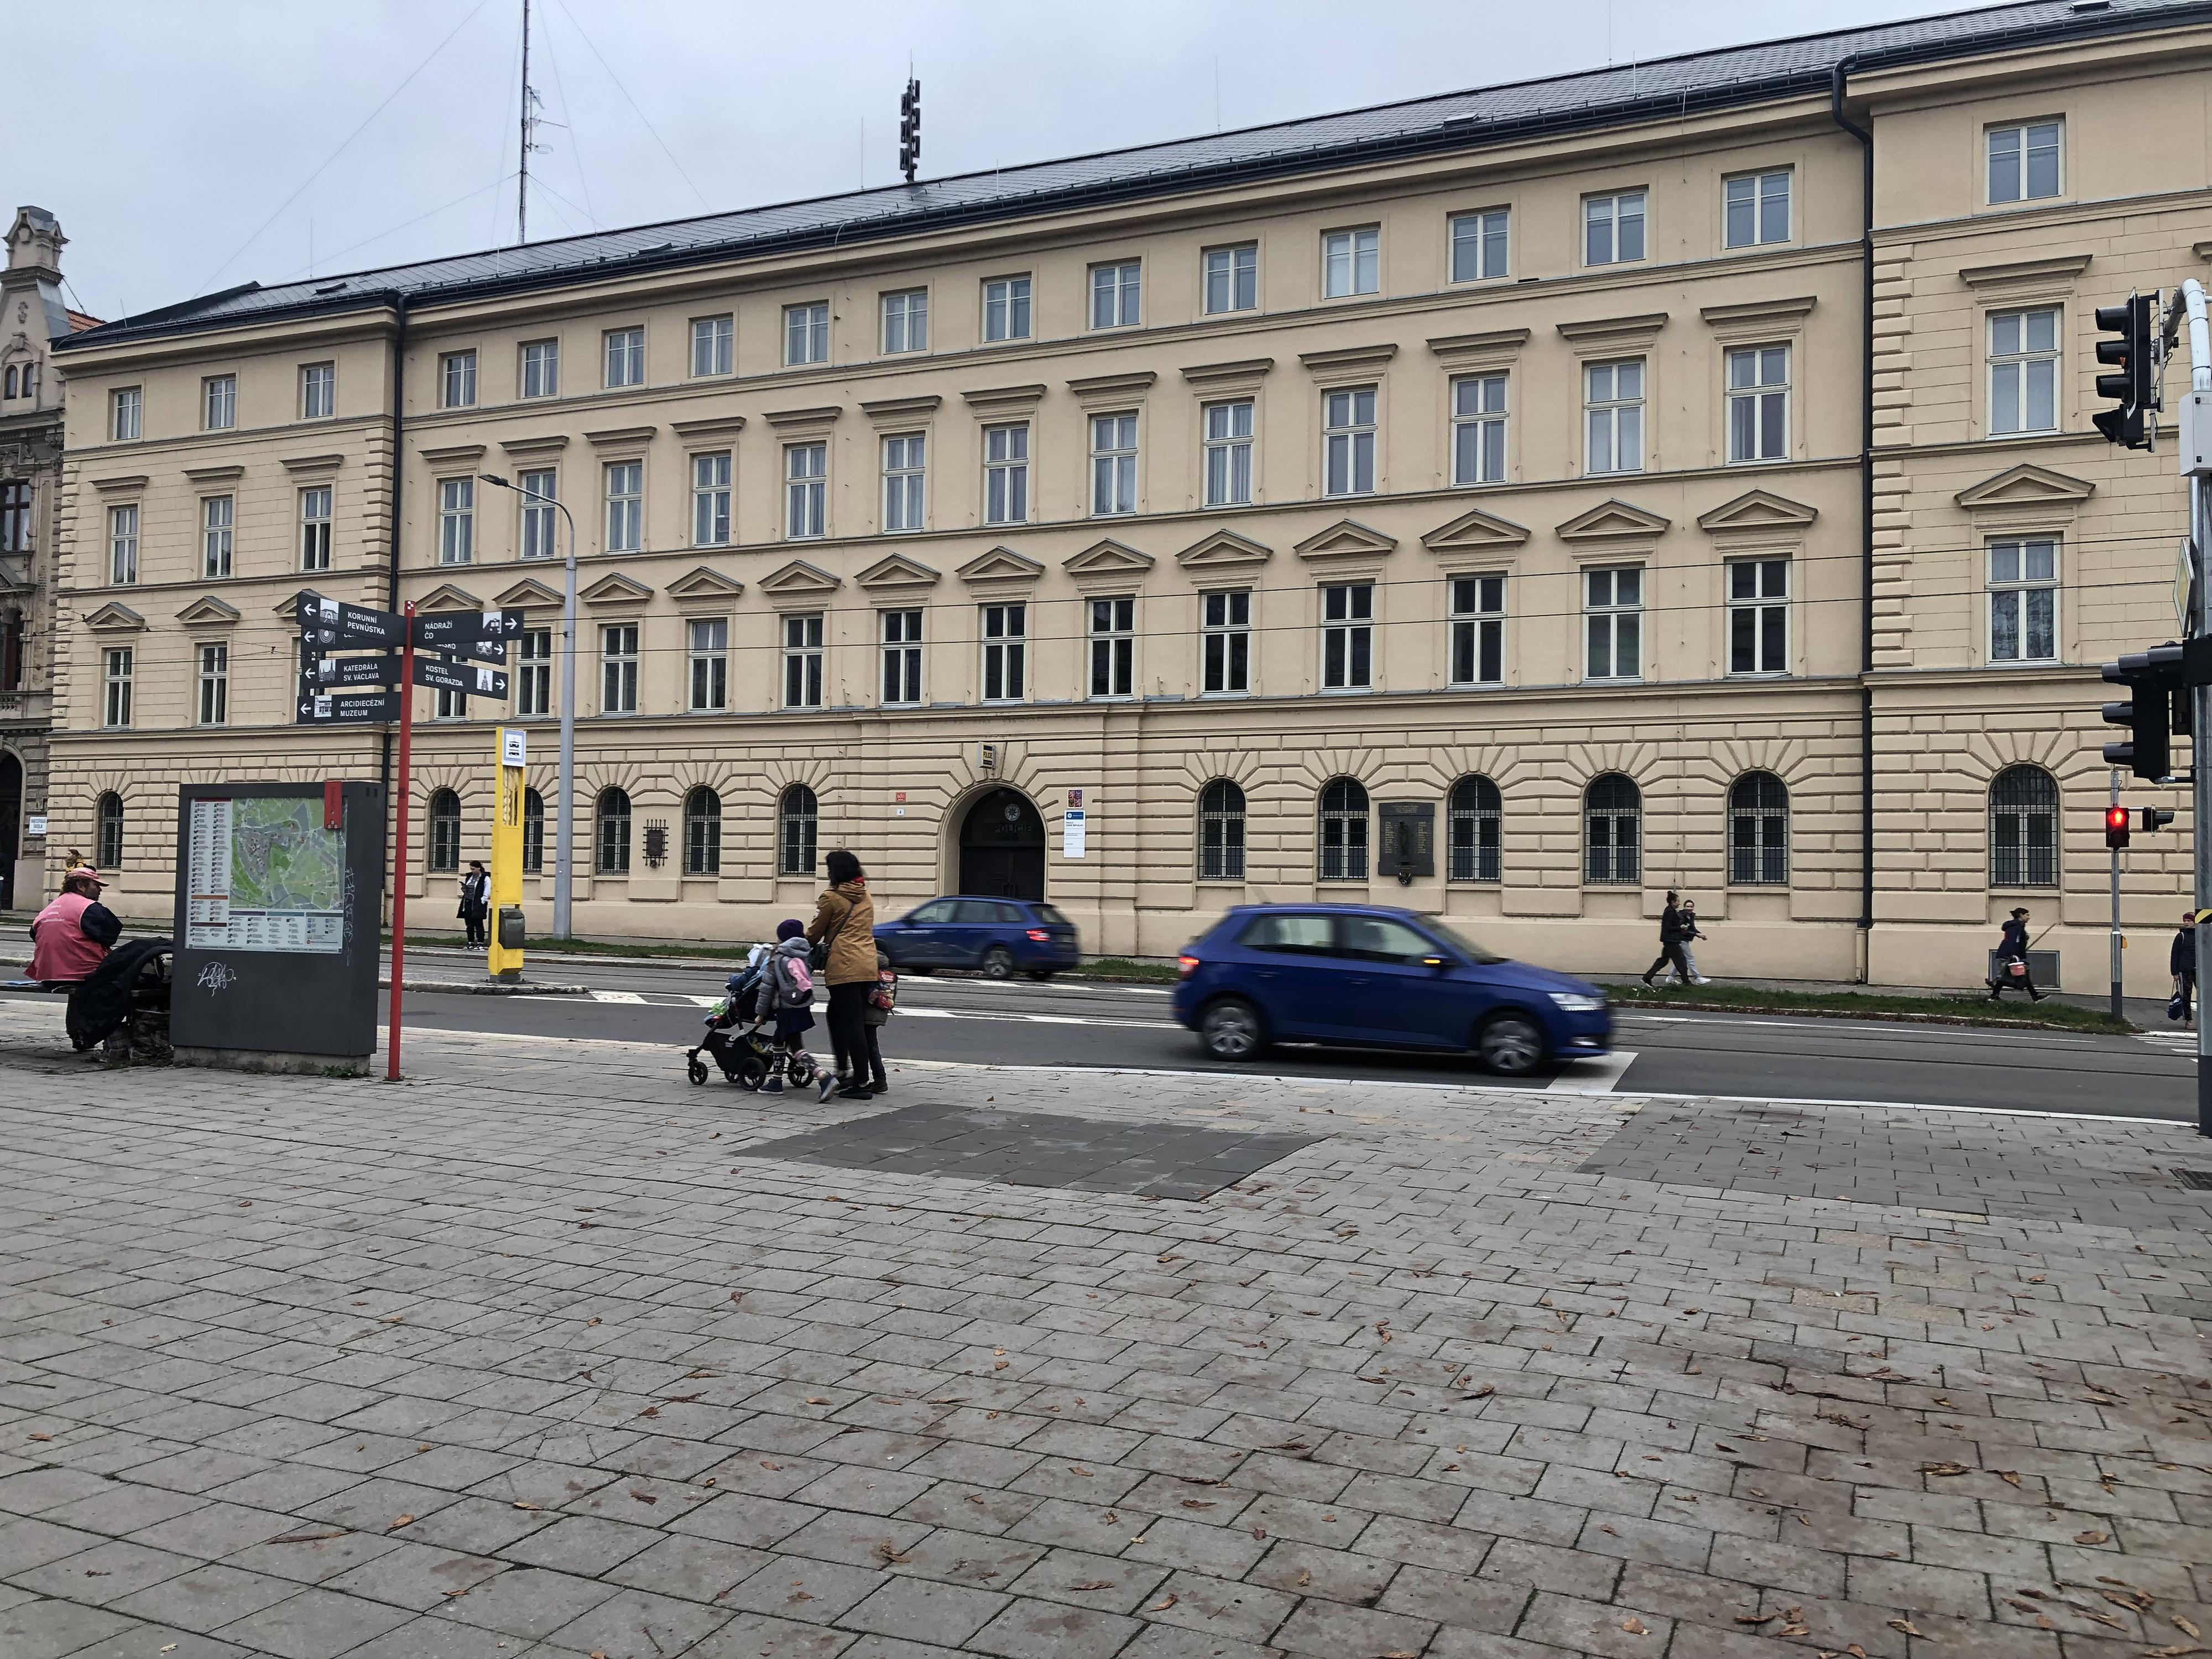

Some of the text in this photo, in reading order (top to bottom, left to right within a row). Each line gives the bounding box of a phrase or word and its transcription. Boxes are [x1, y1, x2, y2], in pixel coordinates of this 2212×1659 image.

[347, 611, 377, 624] KORUNNÍ
[347, 621, 385, 635] PEVNŮSTKA
[425, 620, 453, 630] NÁDRAŽÍ
[424, 631, 434, 639] ČD
[343, 662, 378, 672] KATEDRÁLA
[425, 665, 448, 675] KOSTEL
[353, 672, 379, 681] VÁCLAVA
[435, 676, 464, 687] GORAZDA
[340, 698, 385, 707] ARCIDIECÉZNÍ
[340, 709, 368, 717] MUZEUM
